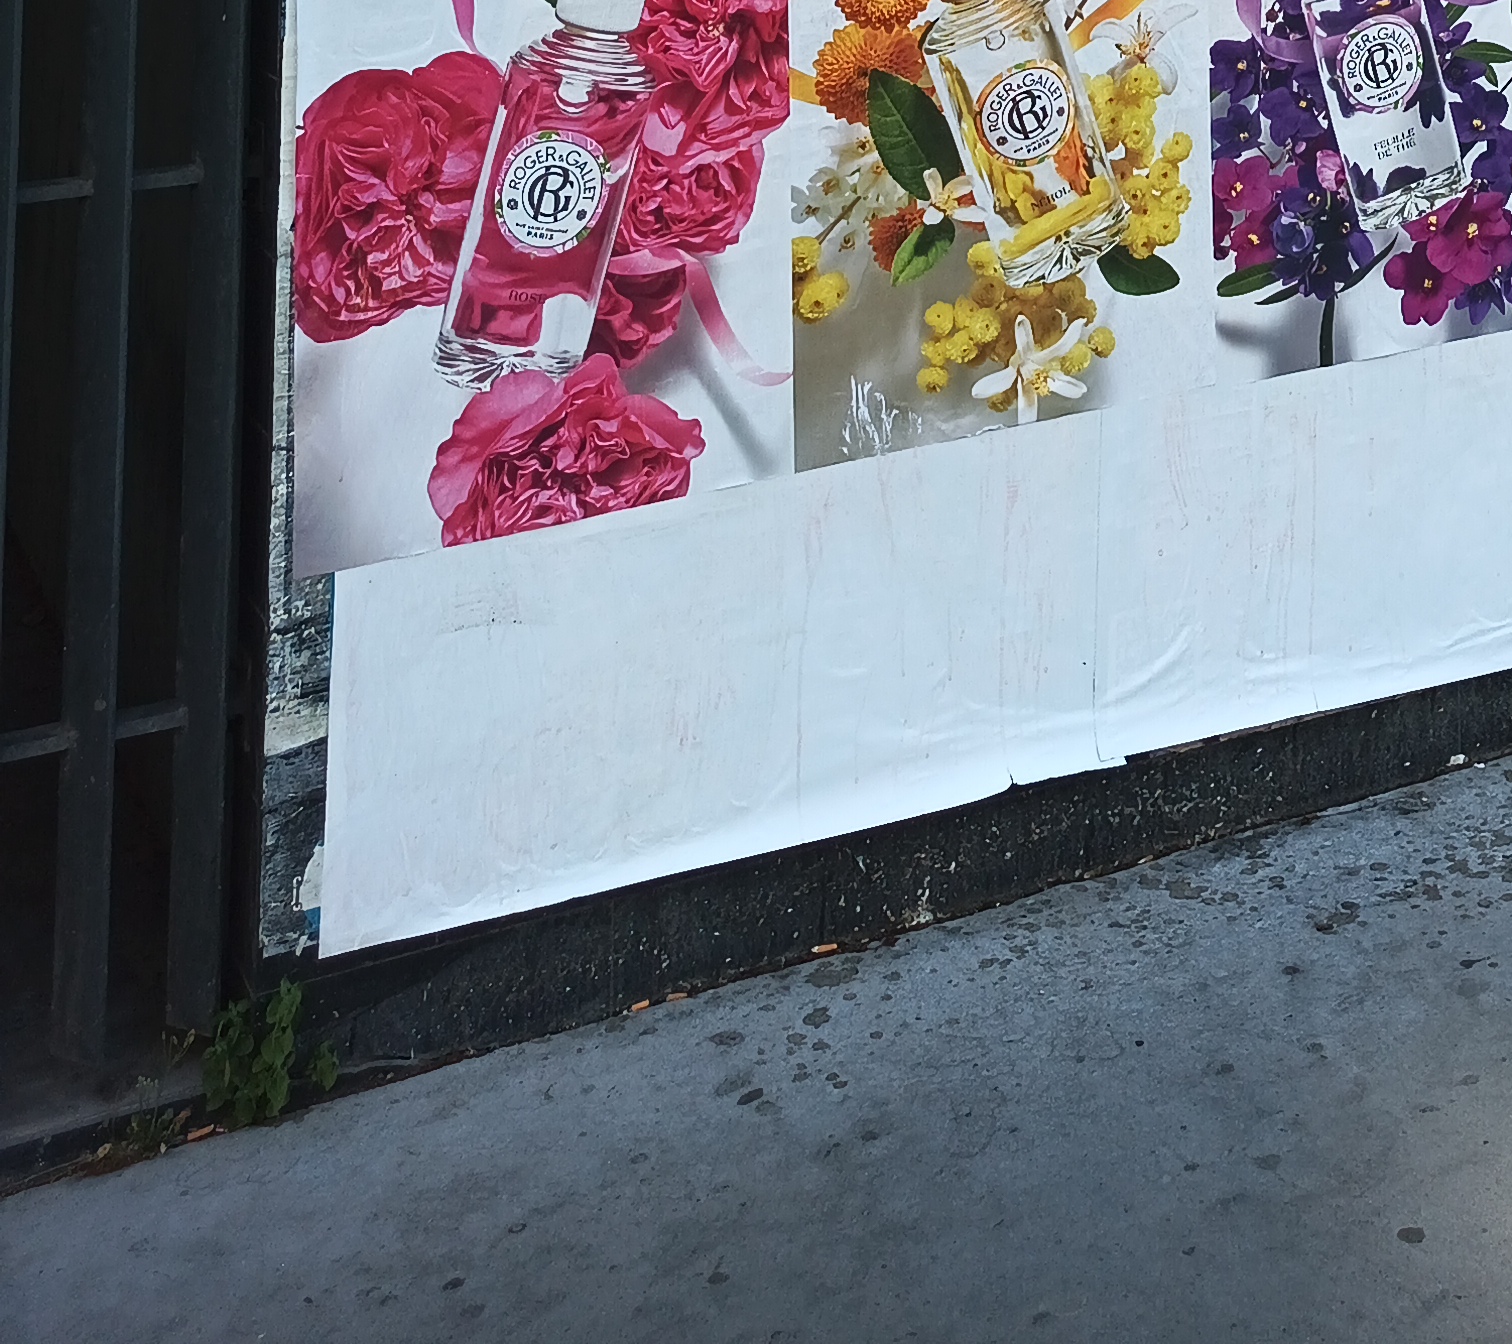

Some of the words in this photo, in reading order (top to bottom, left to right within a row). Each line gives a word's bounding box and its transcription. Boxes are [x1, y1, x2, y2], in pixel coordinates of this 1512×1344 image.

[1378, 90, 1398, 102] PARIS
[1374, 127, 1415, 150] FEUILLE
[1027, 139, 1050, 154] PARIS
[527, 231, 554, 240] PARIS
[509, 289, 547, 304] ROSE
